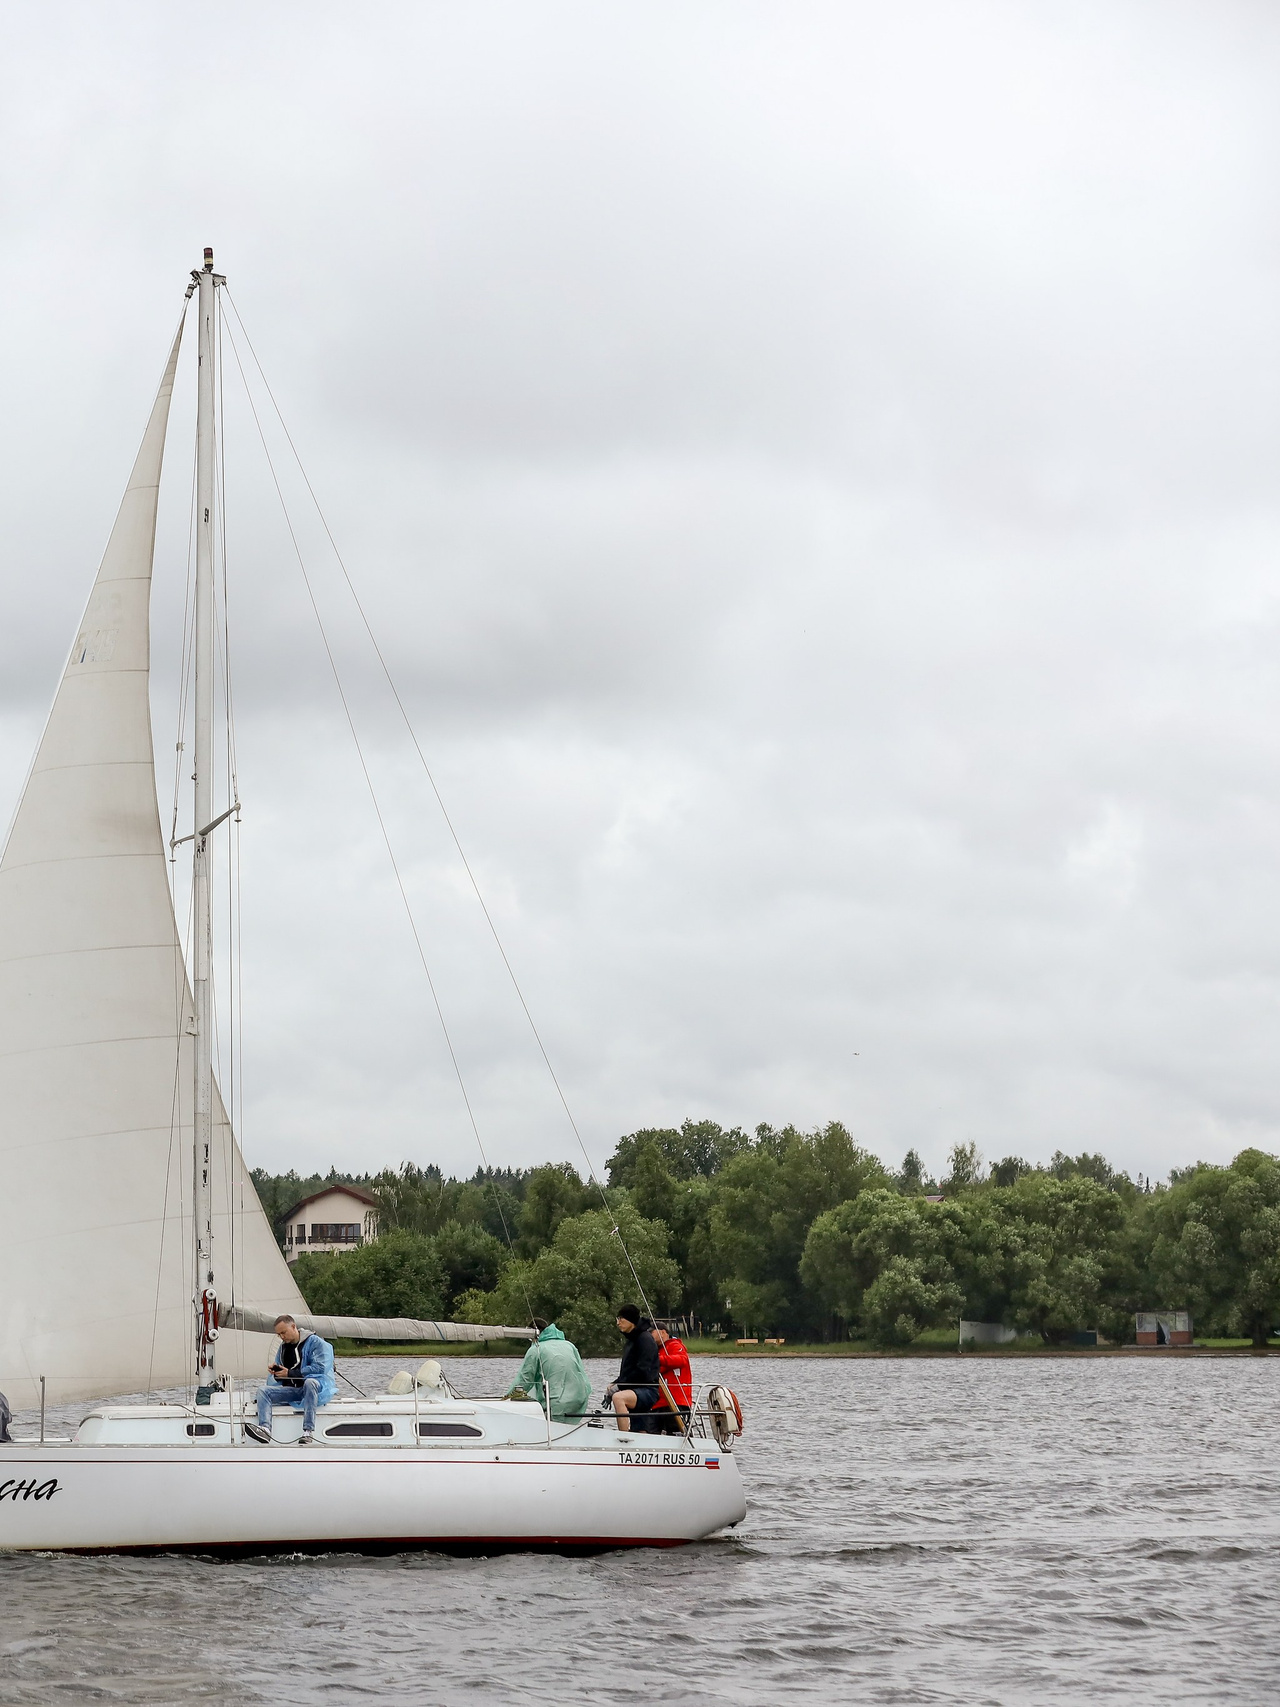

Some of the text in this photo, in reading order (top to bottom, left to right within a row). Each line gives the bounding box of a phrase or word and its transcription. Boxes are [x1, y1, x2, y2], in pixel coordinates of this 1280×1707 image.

[619, 1453, 700, 1465] TA 2071 RUS 50
